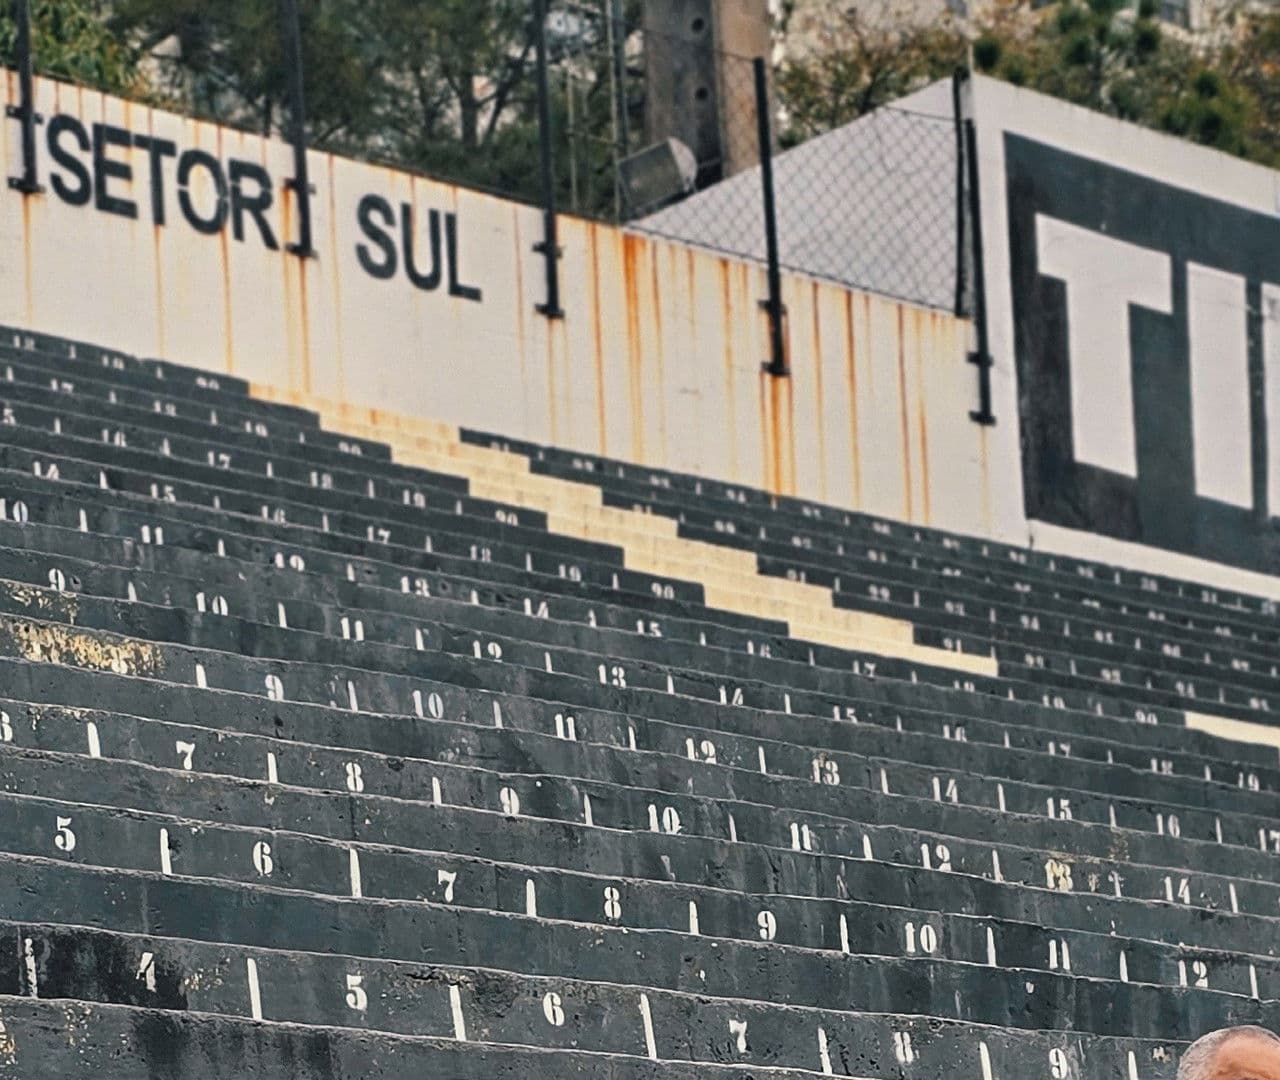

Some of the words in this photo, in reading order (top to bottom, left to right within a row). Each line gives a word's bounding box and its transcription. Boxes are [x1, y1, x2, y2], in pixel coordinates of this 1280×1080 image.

[48, 115, 279, 251] SETOR
[357, 194, 482, 301] SUL
[46, 569, 65, 594] 9
[197, 593, 227, 615] 10
[341, 618, 363, 641] 11
[599, 665, 626, 688] 13
[717, 686, 743, 706] 14
[176, 741, 195, 770] 7
[346, 763, 363, 792] 8
[648, 805, 682, 835] 10
[791, 823, 814, 851] 11
[1162, 877, 1190, 905] 14
[265, 675, 288, 702] 9
[413, 691, 443, 721] 10
[554, 714, 576, 741] 11
[933, 777, 957, 804] 14
[1047, 798, 1072, 820] 15
[1157, 814, 1180, 838] 16
[55, 817, 75, 851] 5
[253, 842, 272, 876] 6
[438, 870, 456, 902] 7
[605, 887, 621, 918] 8
[758, 911, 776, 940] 9
[905, 923, 936, 953] 10
[1049, 940, 1070, 971] 11
[1179, 961, 1208, 990] 12
[346, 975, 367, 1010] 5
[543, 993, 564, 1026] 6
[729, 1020, 747, 1053] 7
[1049, 1049, 1070, 1079] 9
